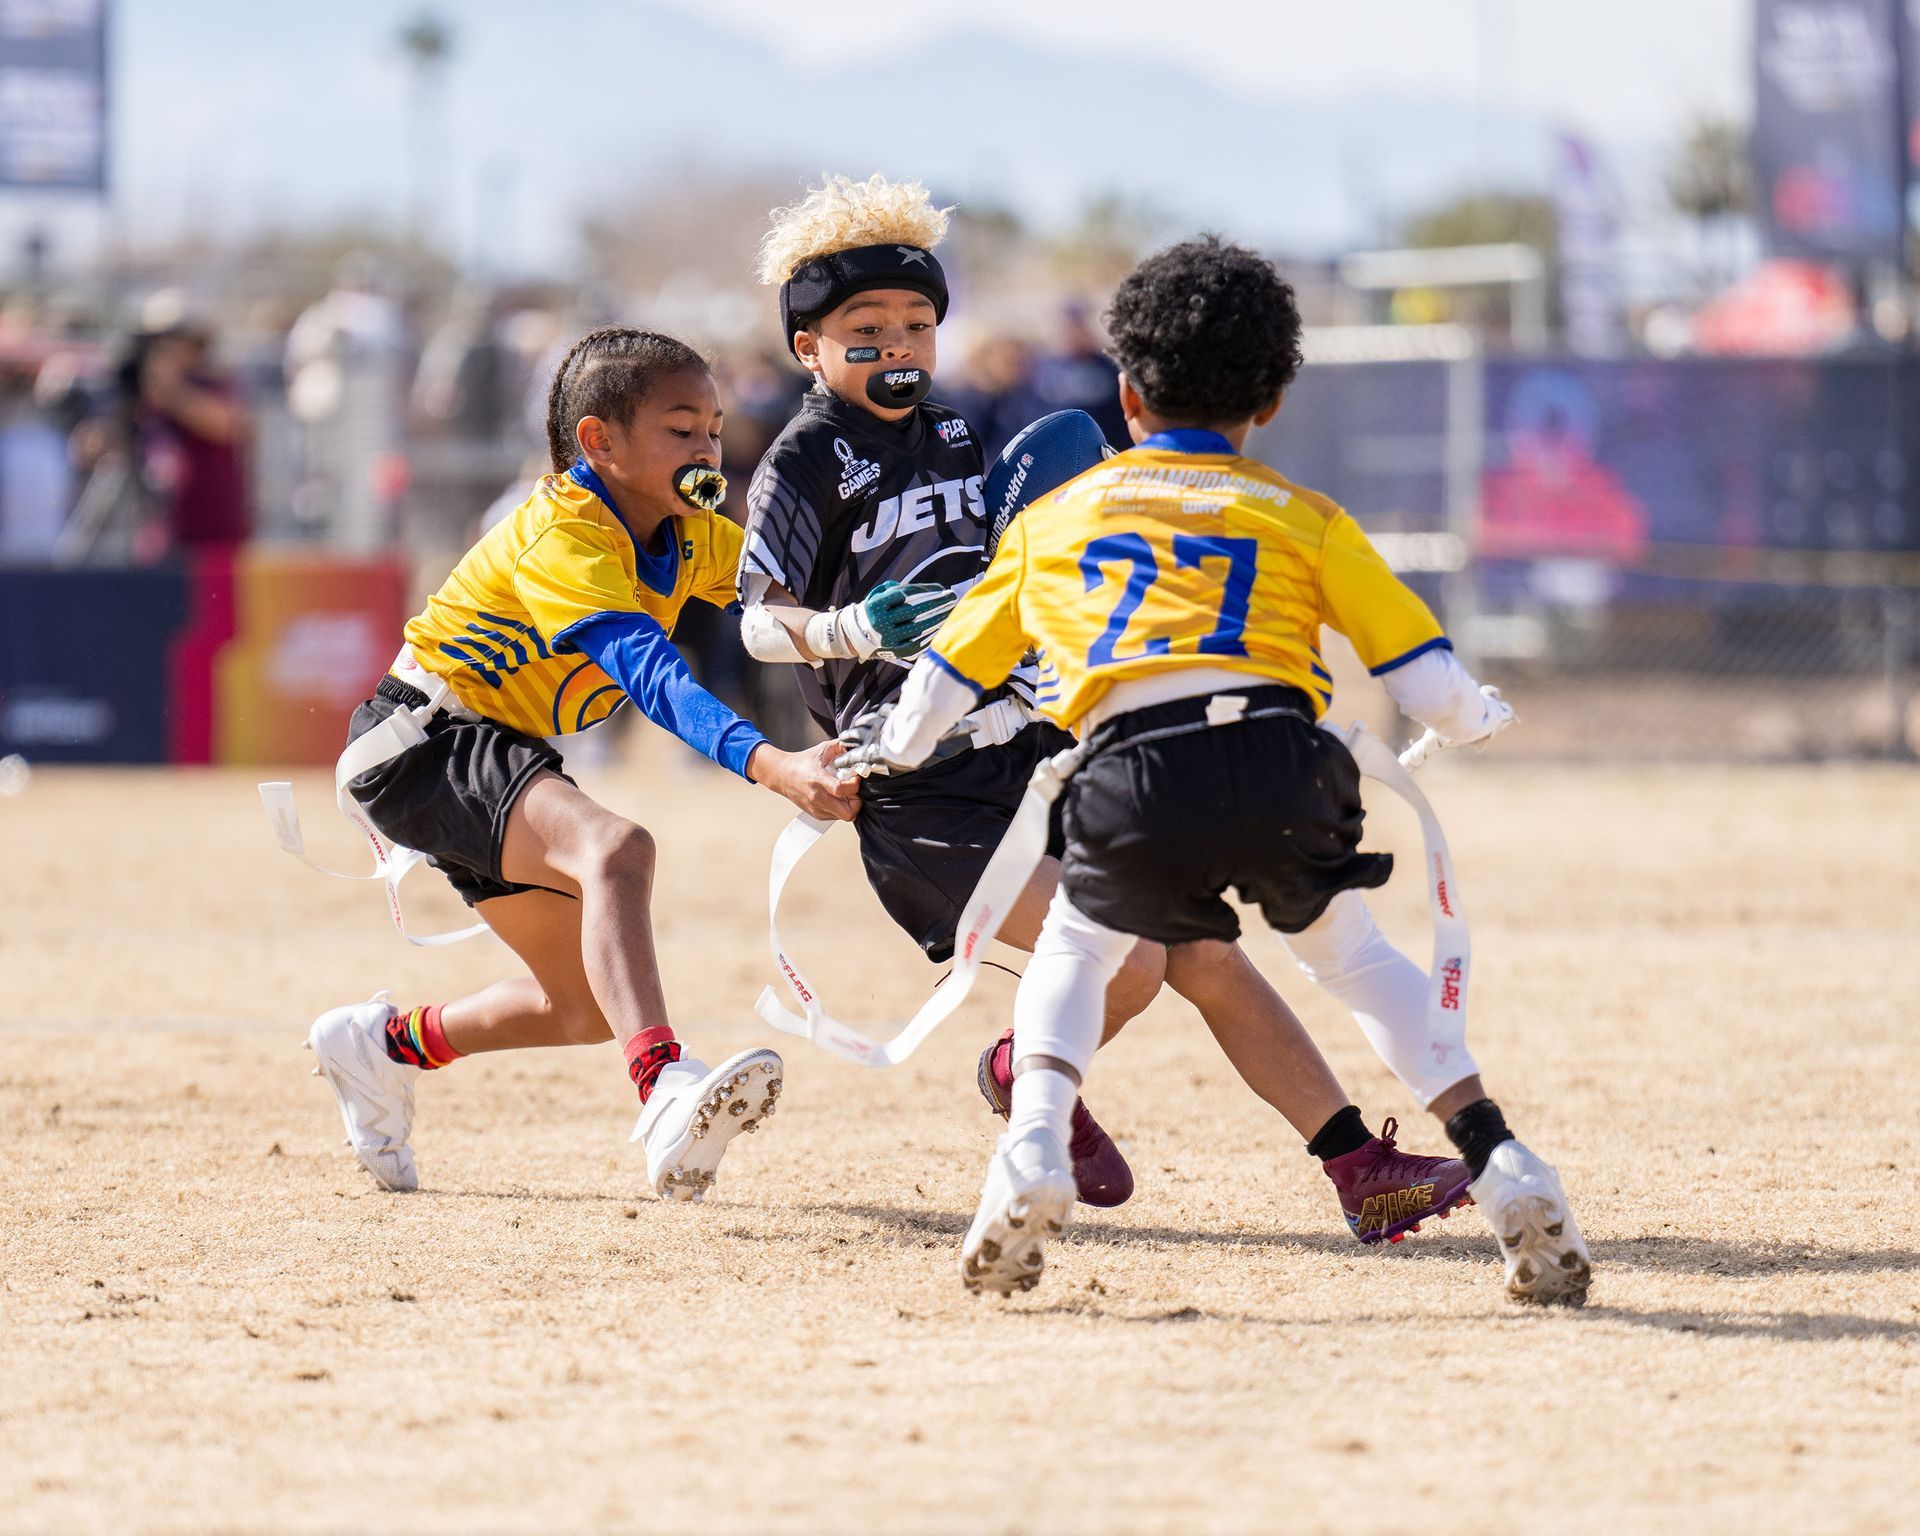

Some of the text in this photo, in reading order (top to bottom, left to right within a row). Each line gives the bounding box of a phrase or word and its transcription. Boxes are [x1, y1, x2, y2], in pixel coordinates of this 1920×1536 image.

[891, 370, 920, 386] FLAG
[838, 462, 880, 500] GAMES
[1123, 465, 1293, 508] CHAMPIONSHIPS
[851, 474, 987, 553] JETS
[1078, 532, 1258, 668] 27
[783, 964, 813, 1002] FLAG
[1440, 967, 1461, 1011] FLAG
[1358, 1184, 1434, 1236] NIKE
